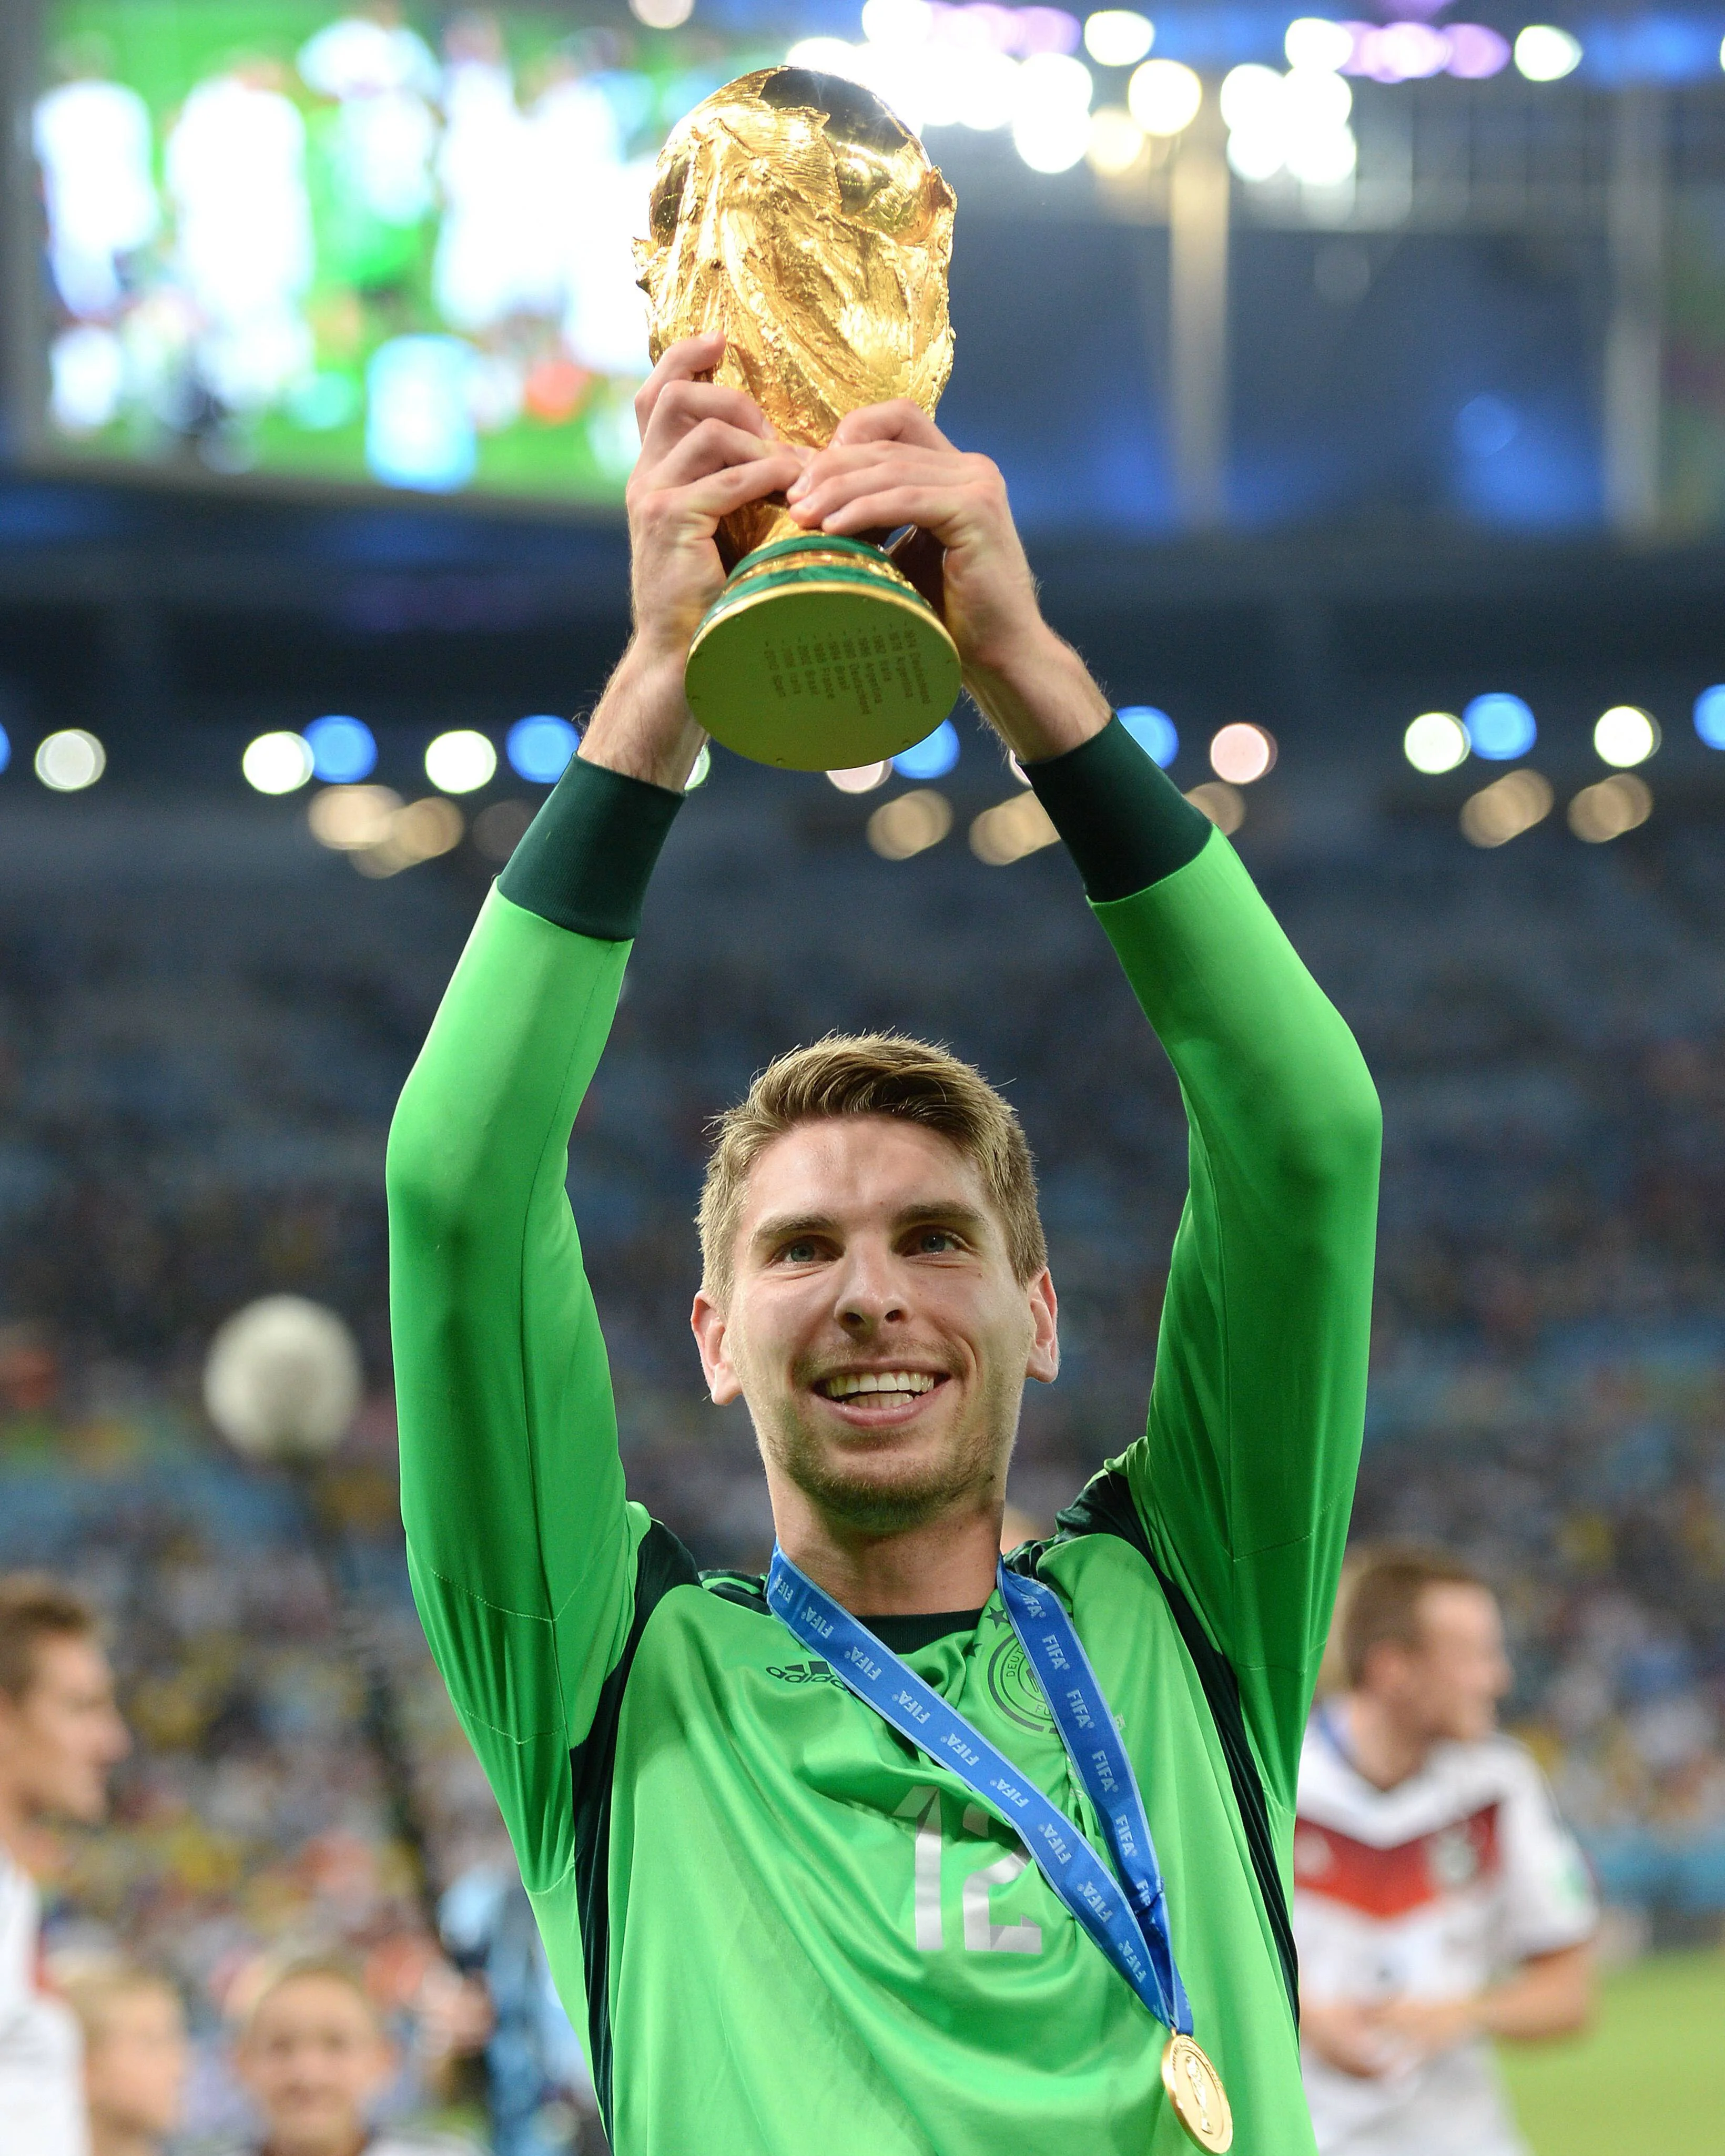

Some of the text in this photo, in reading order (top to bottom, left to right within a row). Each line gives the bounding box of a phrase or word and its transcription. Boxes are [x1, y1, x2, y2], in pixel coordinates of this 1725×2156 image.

[821, 666, 835, 699] France
[806, 1606, 834, 1639] FIFA
[850, 1646, 882, 1681] FIFA
[1006, 1647, 1024, 1677] DEUT
[1042, 1634, 1066, 1670] FIFA
[766, 1666, 847, 1691] adida
[898, 1690, 931, 1724] FIFA
[1067, 1690, 1090, 1729] FIFA
[947, 1733, 980, 1766] FIFA
[1092, 1750, 1115, 1792] FIFA
[996, 1778, 1030, 1808] FIFA
[1043, 1823, 1072, 1864] FIFA
[1115, 1814, 1134, 1856] FIFA
[892, 1785, 1042, 1955] 12
[1082, 1880, 1113, 1923] FIFA
[1136, 1879, 1151, 1906] FIF
[1123, 1940, 1146, 1983] FIFA
